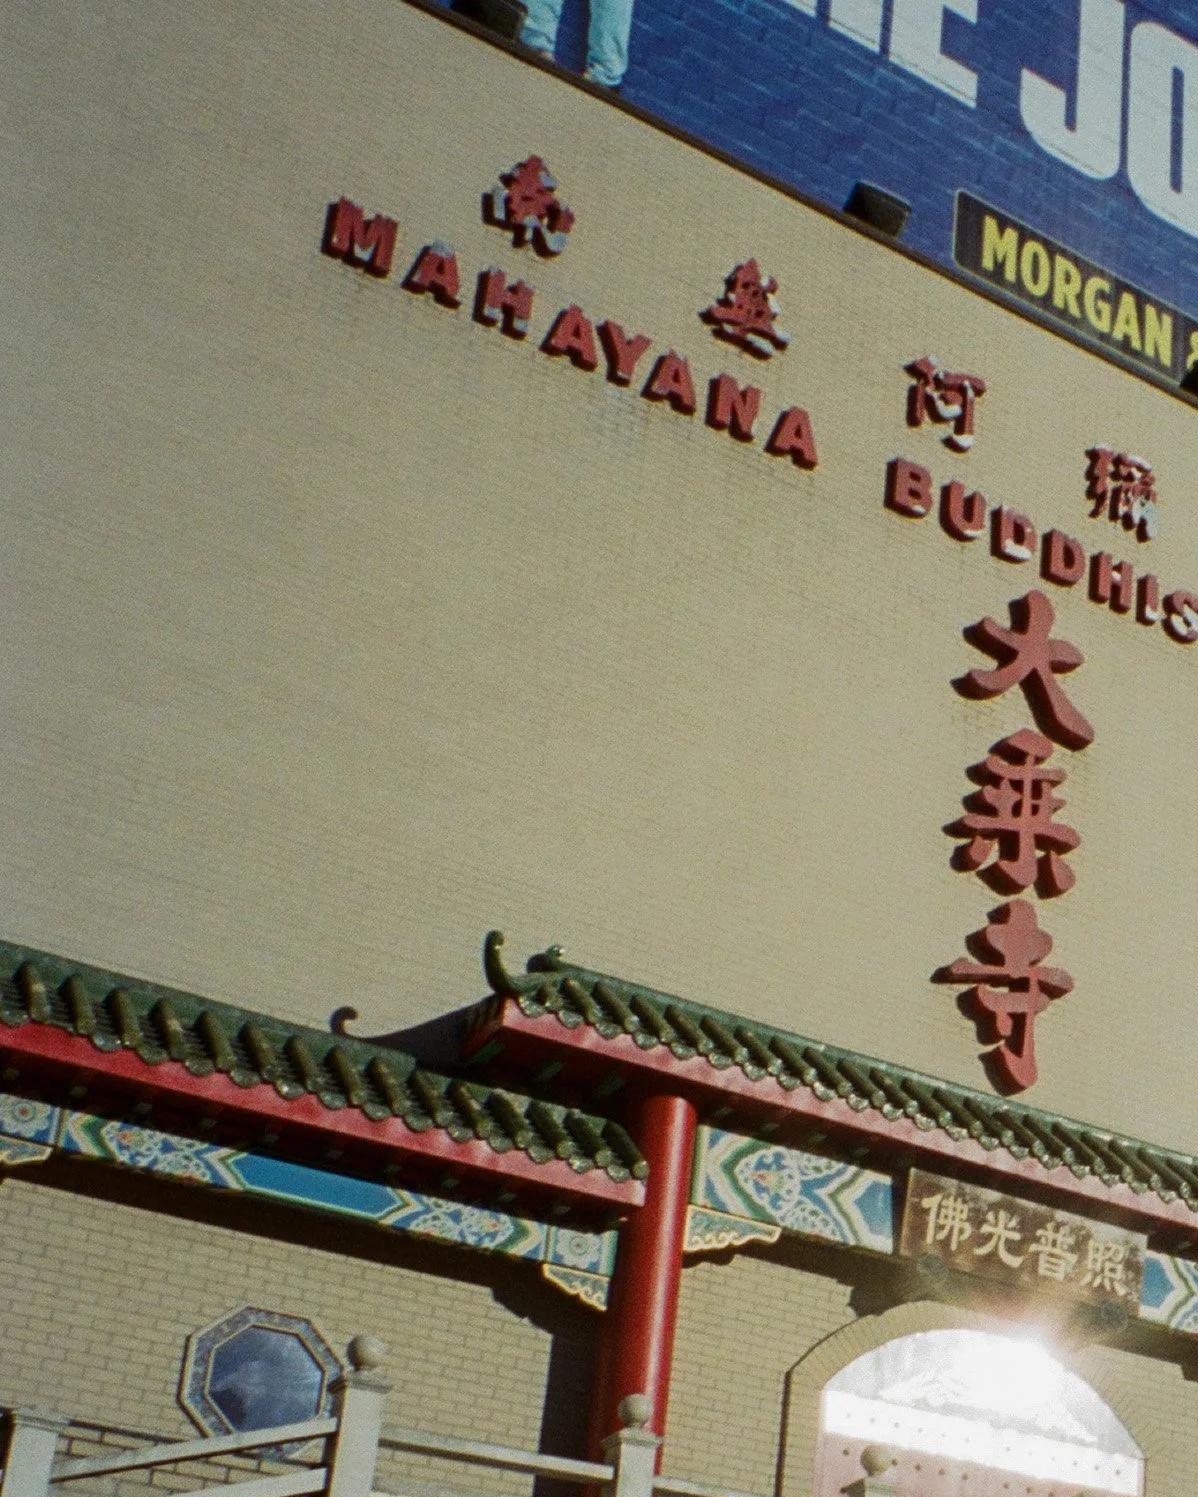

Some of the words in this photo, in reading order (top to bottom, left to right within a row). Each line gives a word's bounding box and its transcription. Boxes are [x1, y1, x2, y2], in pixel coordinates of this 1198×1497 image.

[320, 195, 819, 471] MAHAYANA
[981, 214, 1173, 368] MORGAN
[920, 1192, 1129, 1297] 佛光普照
